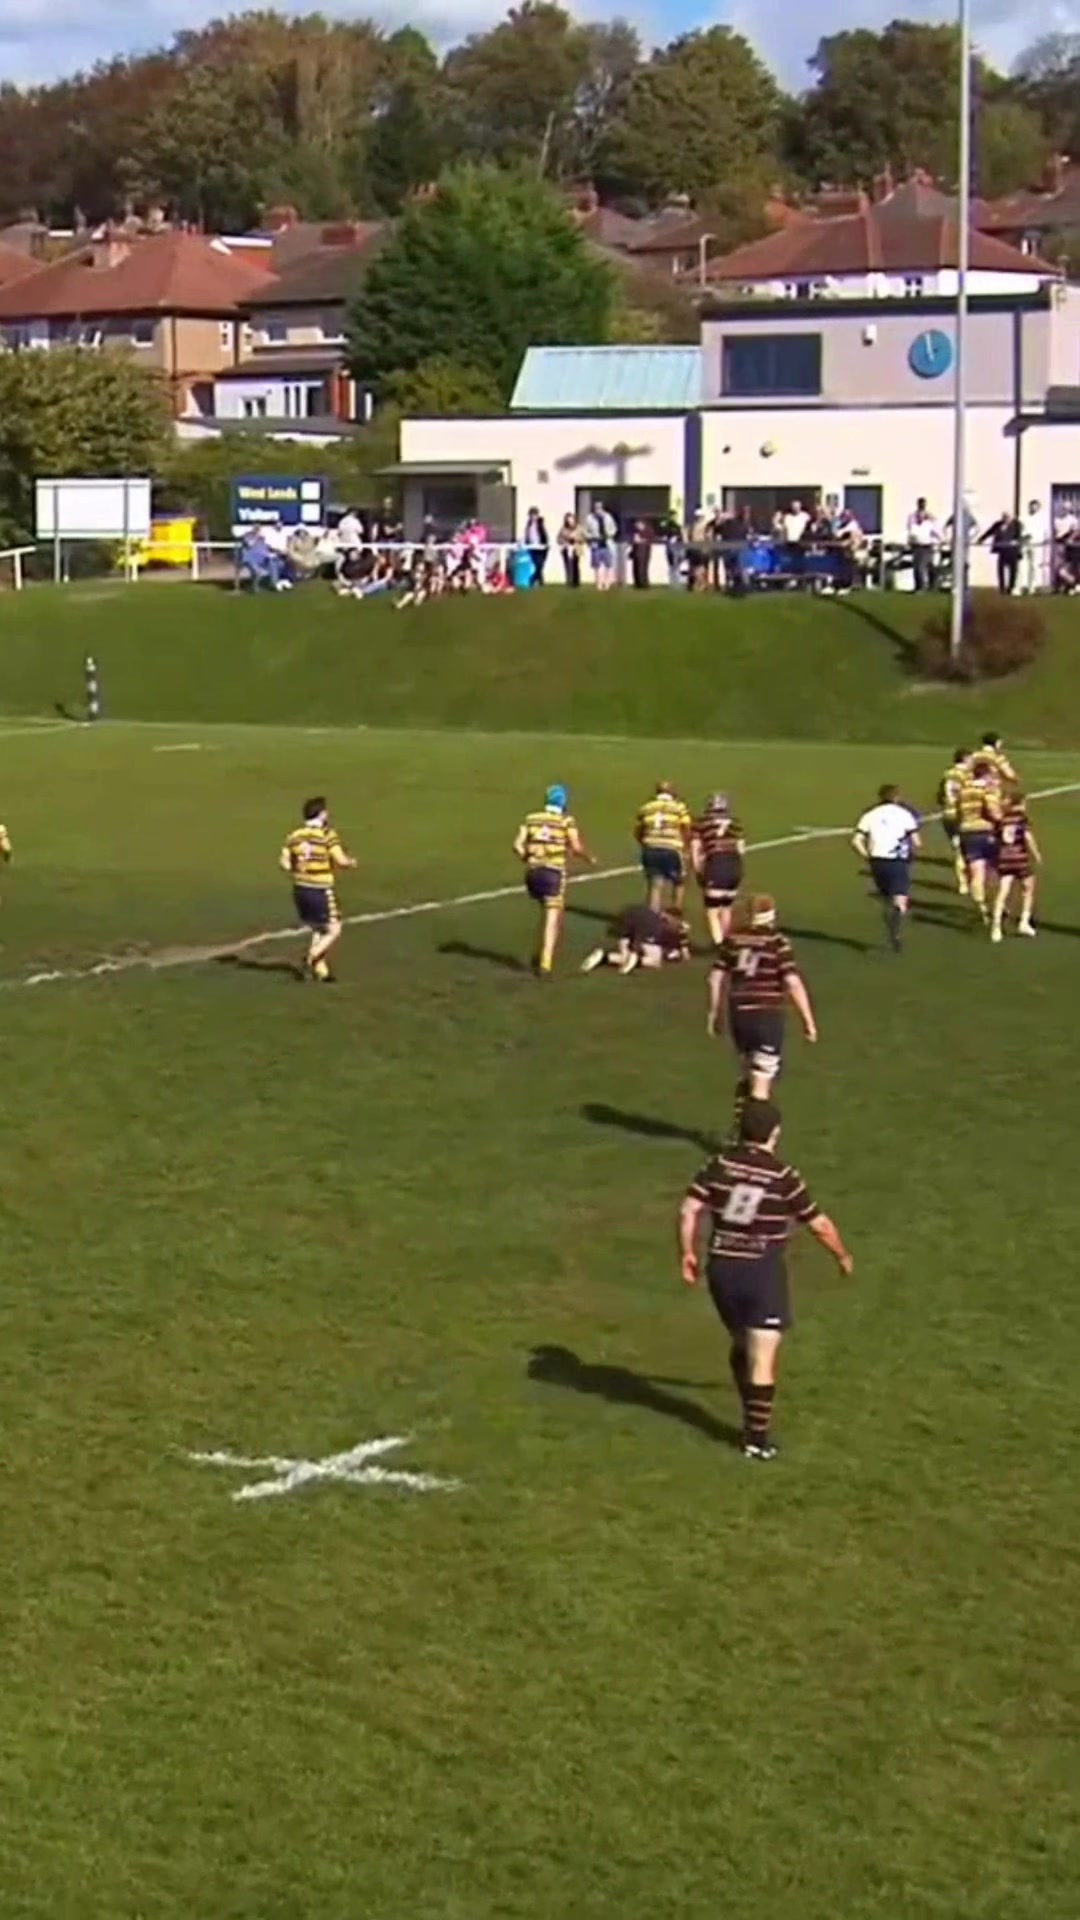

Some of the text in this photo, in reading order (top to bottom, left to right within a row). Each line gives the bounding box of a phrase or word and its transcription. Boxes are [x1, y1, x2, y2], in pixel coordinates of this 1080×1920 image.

[713, 818, 732, 837] 7
[736, 948, 761, 977] 4
[721, 1183, 766, 1225] 8
